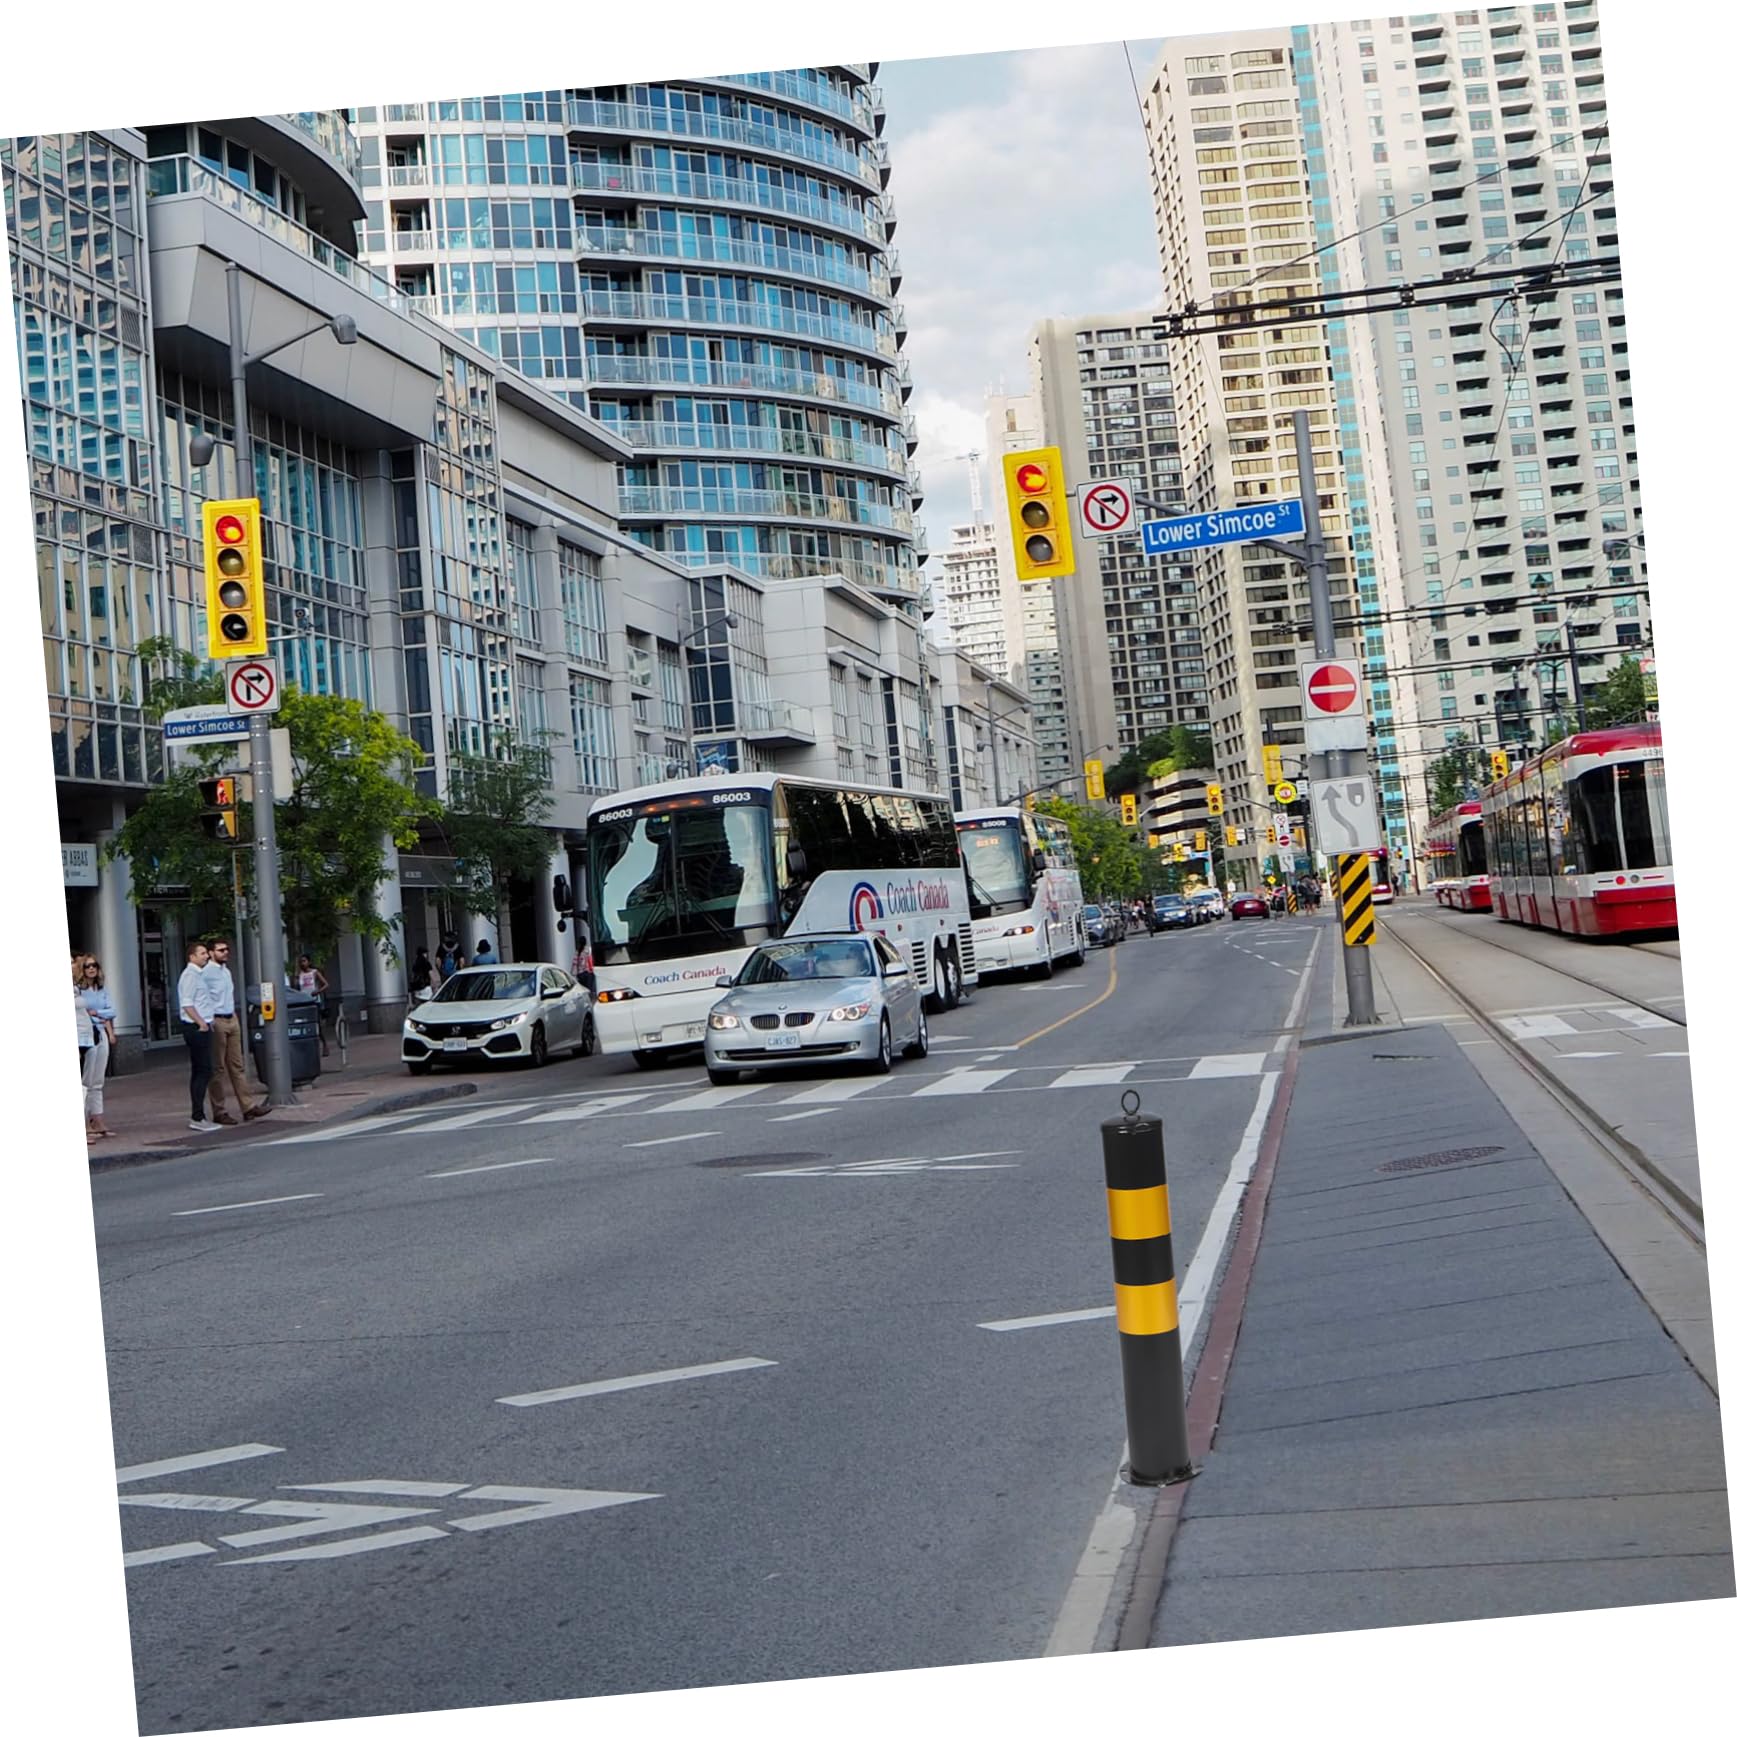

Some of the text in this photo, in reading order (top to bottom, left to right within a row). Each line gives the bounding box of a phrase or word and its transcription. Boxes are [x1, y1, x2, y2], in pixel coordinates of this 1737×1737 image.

[1149, 504, 1290, 546] Lower Simcoe St
[167, 720, 245, 736] Lower Simcoe St
[712, 792, 751, 804] 86003
[598, 808, 633, 823] 86003
[887, 877, 950, 914] Coach Canada
[644, 966, 726, 985] Coach Canada
